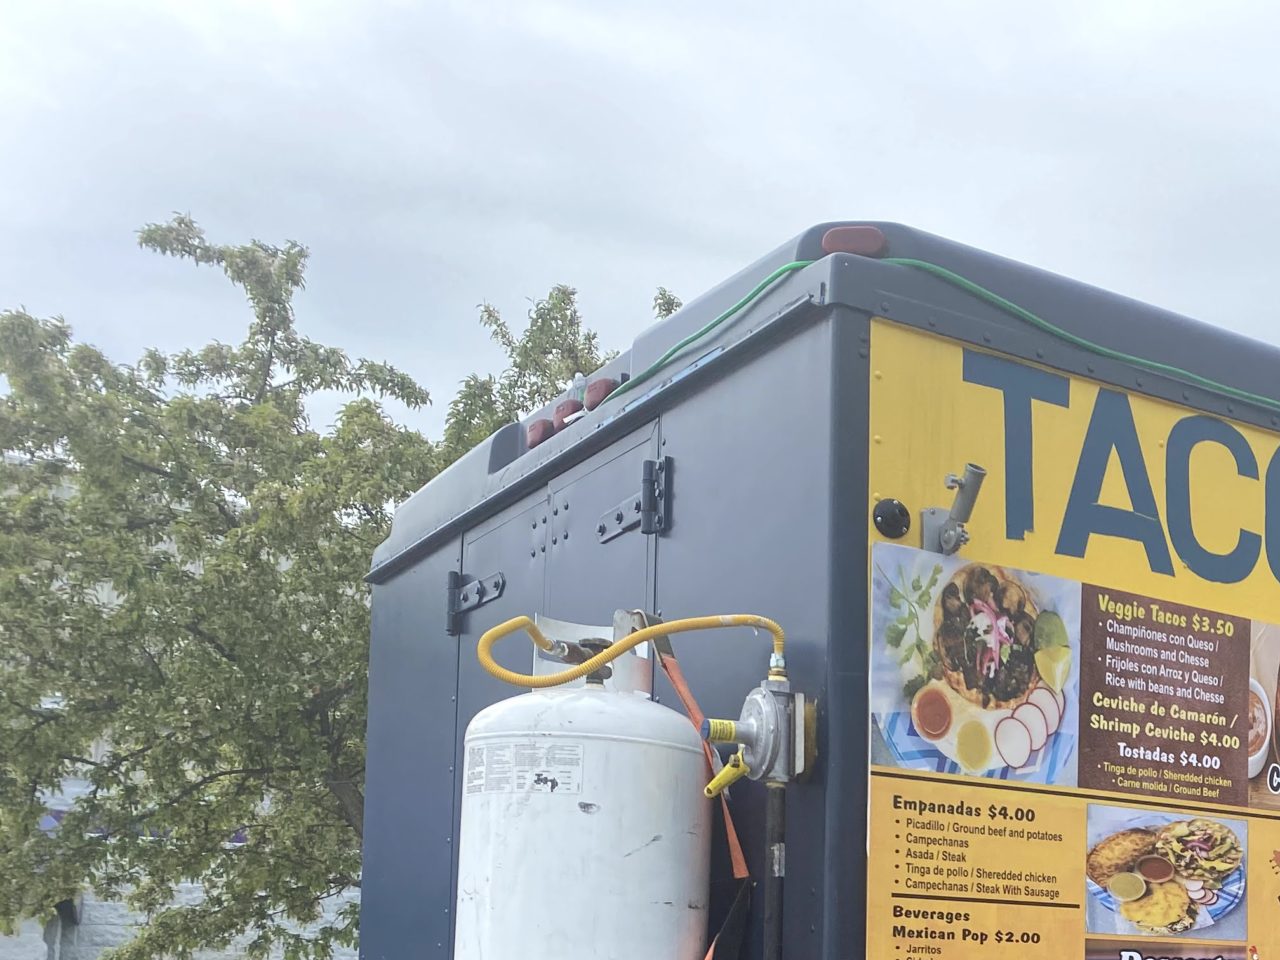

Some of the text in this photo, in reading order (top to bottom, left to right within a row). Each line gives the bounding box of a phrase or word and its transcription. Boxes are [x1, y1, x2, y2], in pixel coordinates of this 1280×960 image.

[1098, 594, 1234, 637] Veggie Tacos $3.50
[1107, 619, 1213, 651] Champiñones con Queso
[1107, 637, 1209, 667] Mushrooms and Chesse
[1106, 655, 1218, 686] Frijoles con Arroz y Queso
[1106, 673, 1224, 704] Rice with beans and Chesse
[1093, 692, 1226, 726] Ceviche de Camarón
[1091, 714, 1240, 749] Shrimp Ceviche $4.00
[1118, 742, 1220, 769] Tostadas $4.00
[1104, 762, 1232, 787] Tinga de pollo Sheredded chicken
[1118, 778, 1219, 798] Carne molida Ground Beef
[893, 795, 1035, 822] Empanadas $4.00
[906, 833, 969, 848] Campechanas
[907, 818, 1062, 842] Picadillo Ground beef and potatoes
[906, 848, 966, 862] Asada Steak
[906, 863, 1056, 883] Tinga de pollo Sheredded chicken
[906, 878, 1059, 900] Campechanas Steak With Sausage
[893, 905, 970, 923] Beverages
[893, 926, 1041, 945] Mexican Pop $2.00
[906, 944, 941, 955] Jarritos
